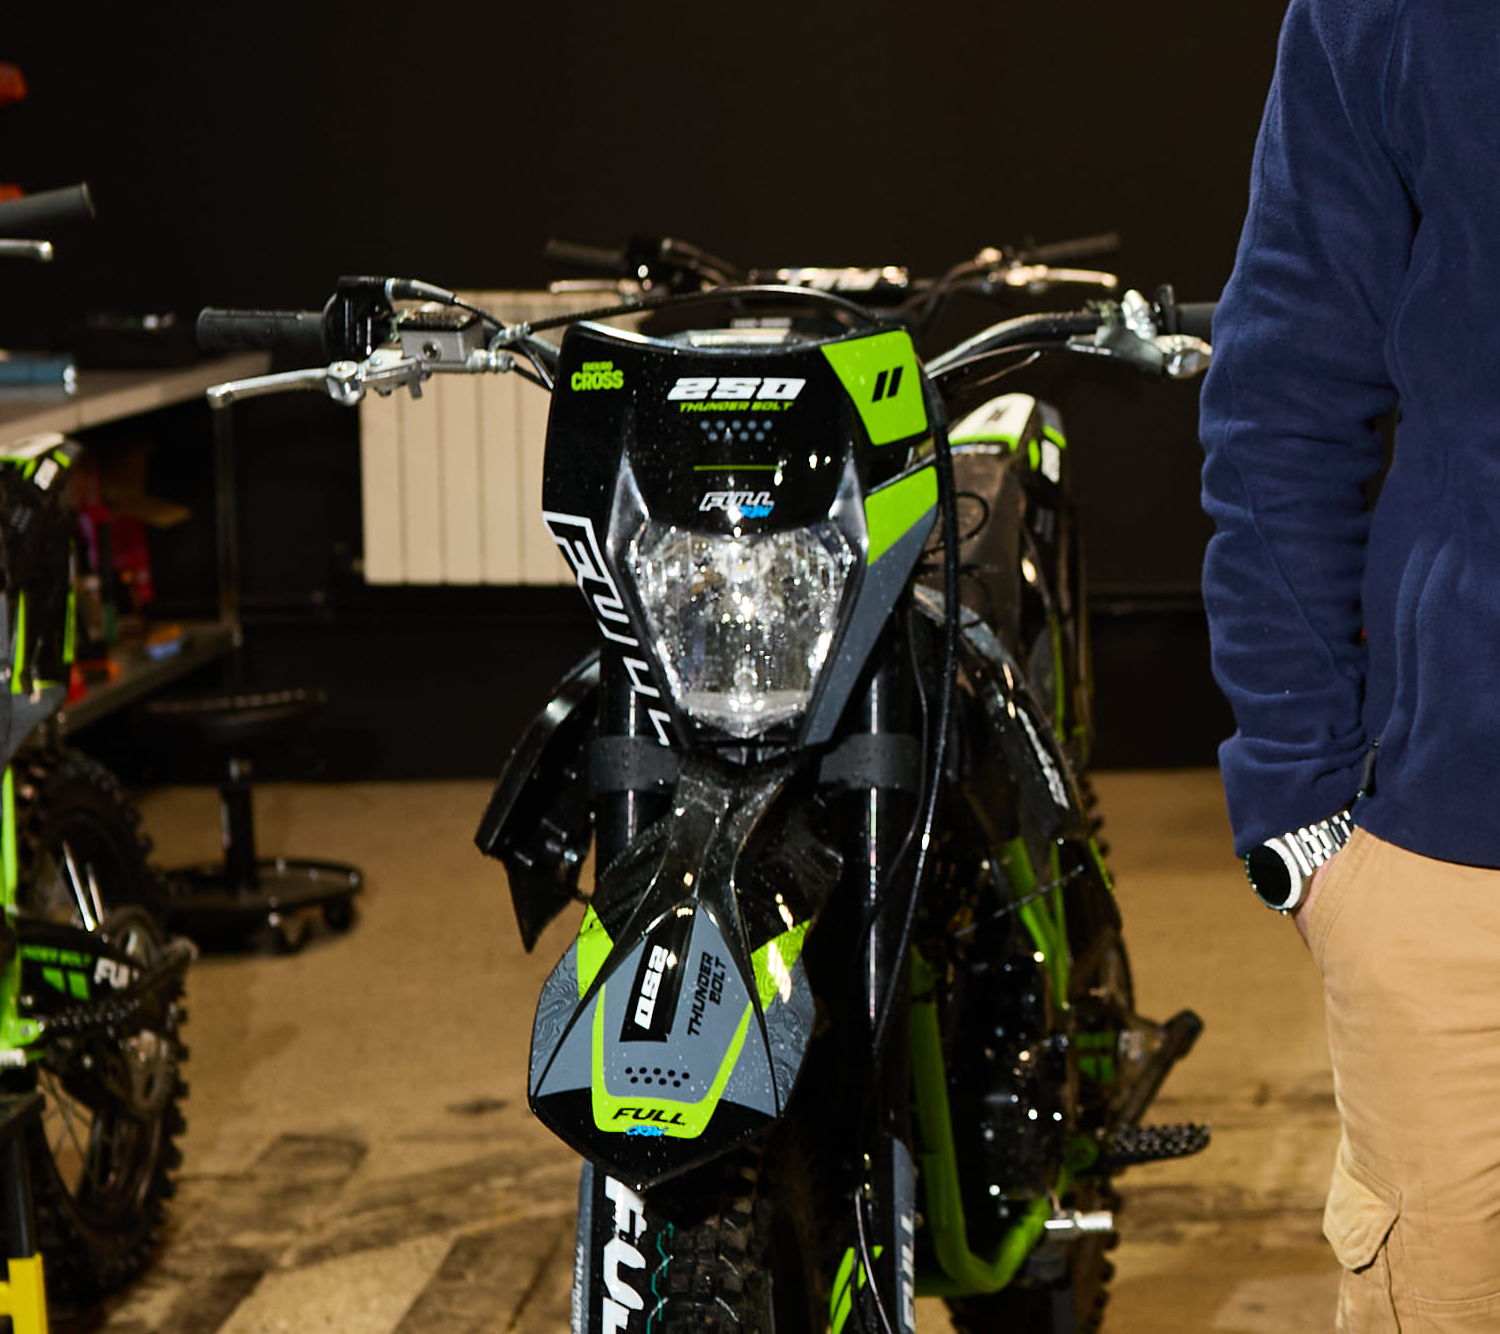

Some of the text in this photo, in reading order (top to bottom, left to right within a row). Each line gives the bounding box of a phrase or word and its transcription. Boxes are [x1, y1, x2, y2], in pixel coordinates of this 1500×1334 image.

[571, 370, 624, 391] CROSS
[667, 377, 806, 400] 250
[679, 401, 794, 413] THUNDER BOLT
[634, 944, 669, 1030] 250
[708, 957, 728, 1006] BOLT
[687, 951, 714, 1037] THUNDER
[612, 1107, 687, 1126] FULL
